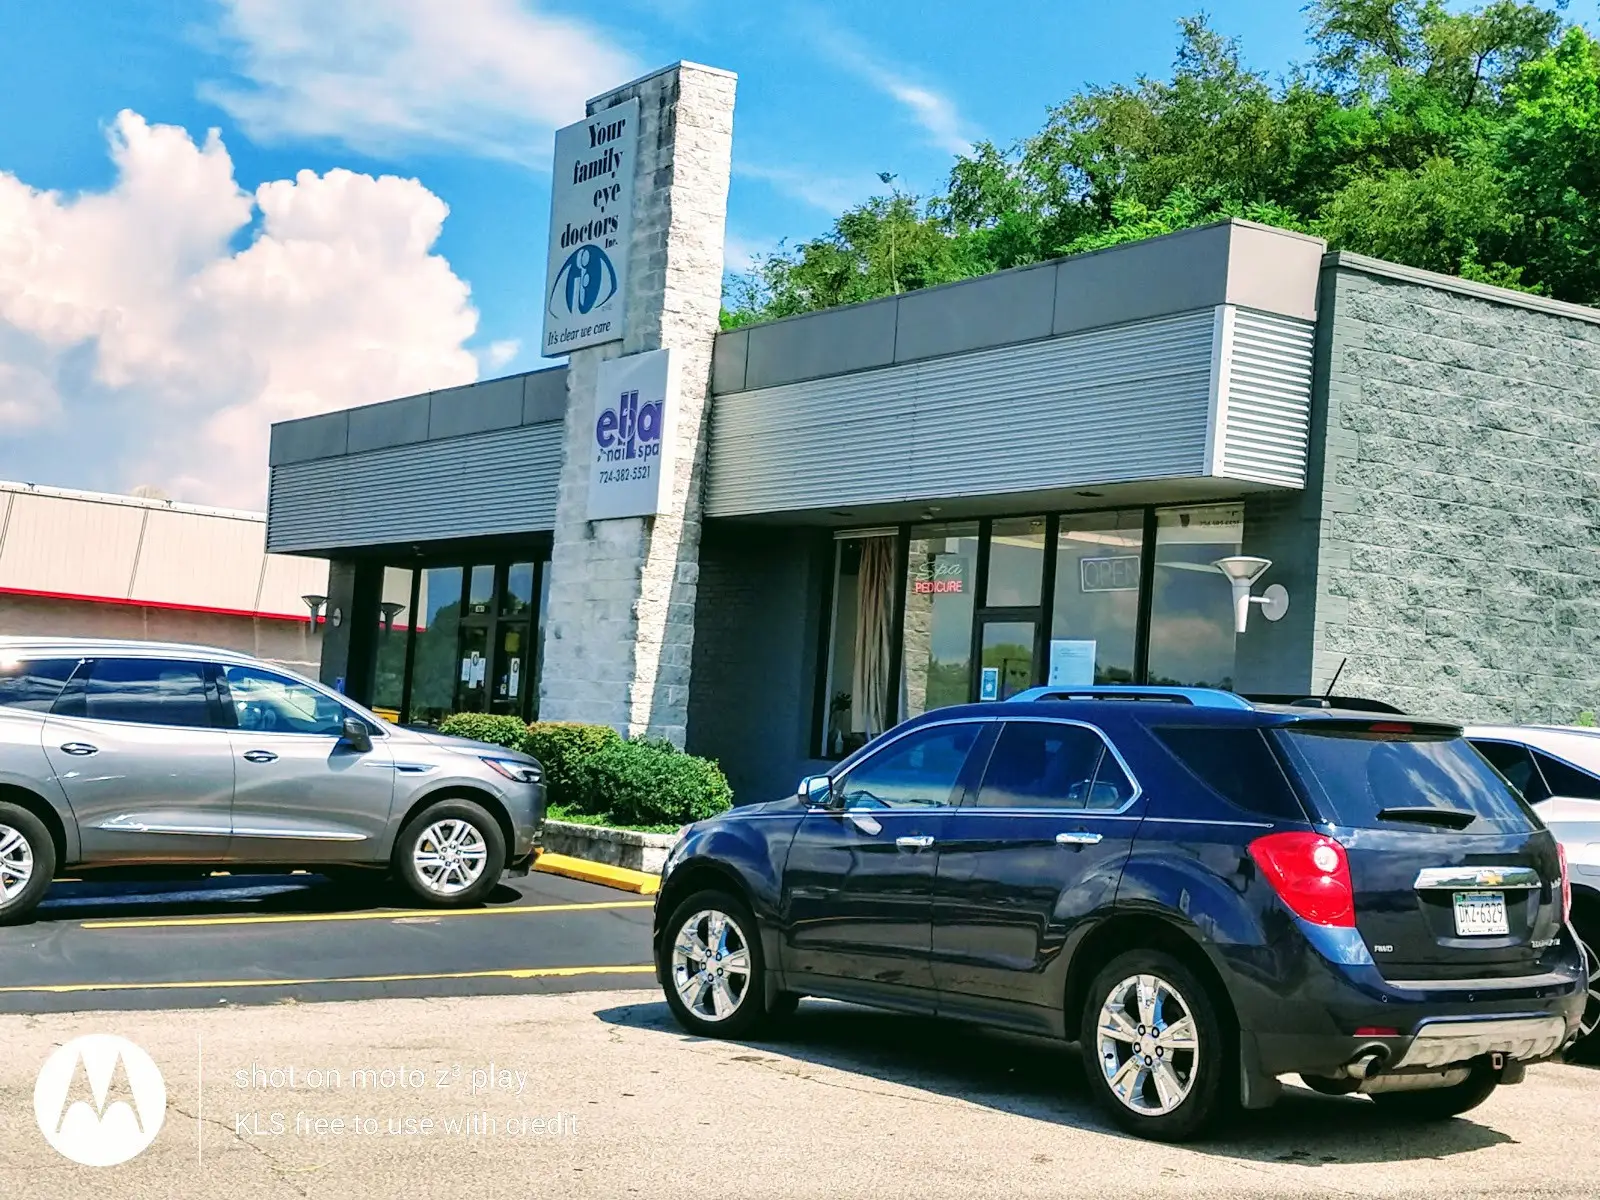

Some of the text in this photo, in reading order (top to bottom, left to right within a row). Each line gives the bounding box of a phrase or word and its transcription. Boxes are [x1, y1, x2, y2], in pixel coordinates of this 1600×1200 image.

[588, 118, 626, 149] Your
[573, 148, 624, 185] family
[593, 183, 621, 213] eye
[560, 213, 619, 249] doctors
[547, 320, 611, 347] It's clear we care
[596, 389, 663, 459] ella
[638, 442, 660, 462] spa
[599, 466, 651, 484] 724-382-5521
[914, 561, 963, 581] Spa
[1084, 560, 1139, 588] OPEN
[915, 580, 963, 594] PEDICURE
